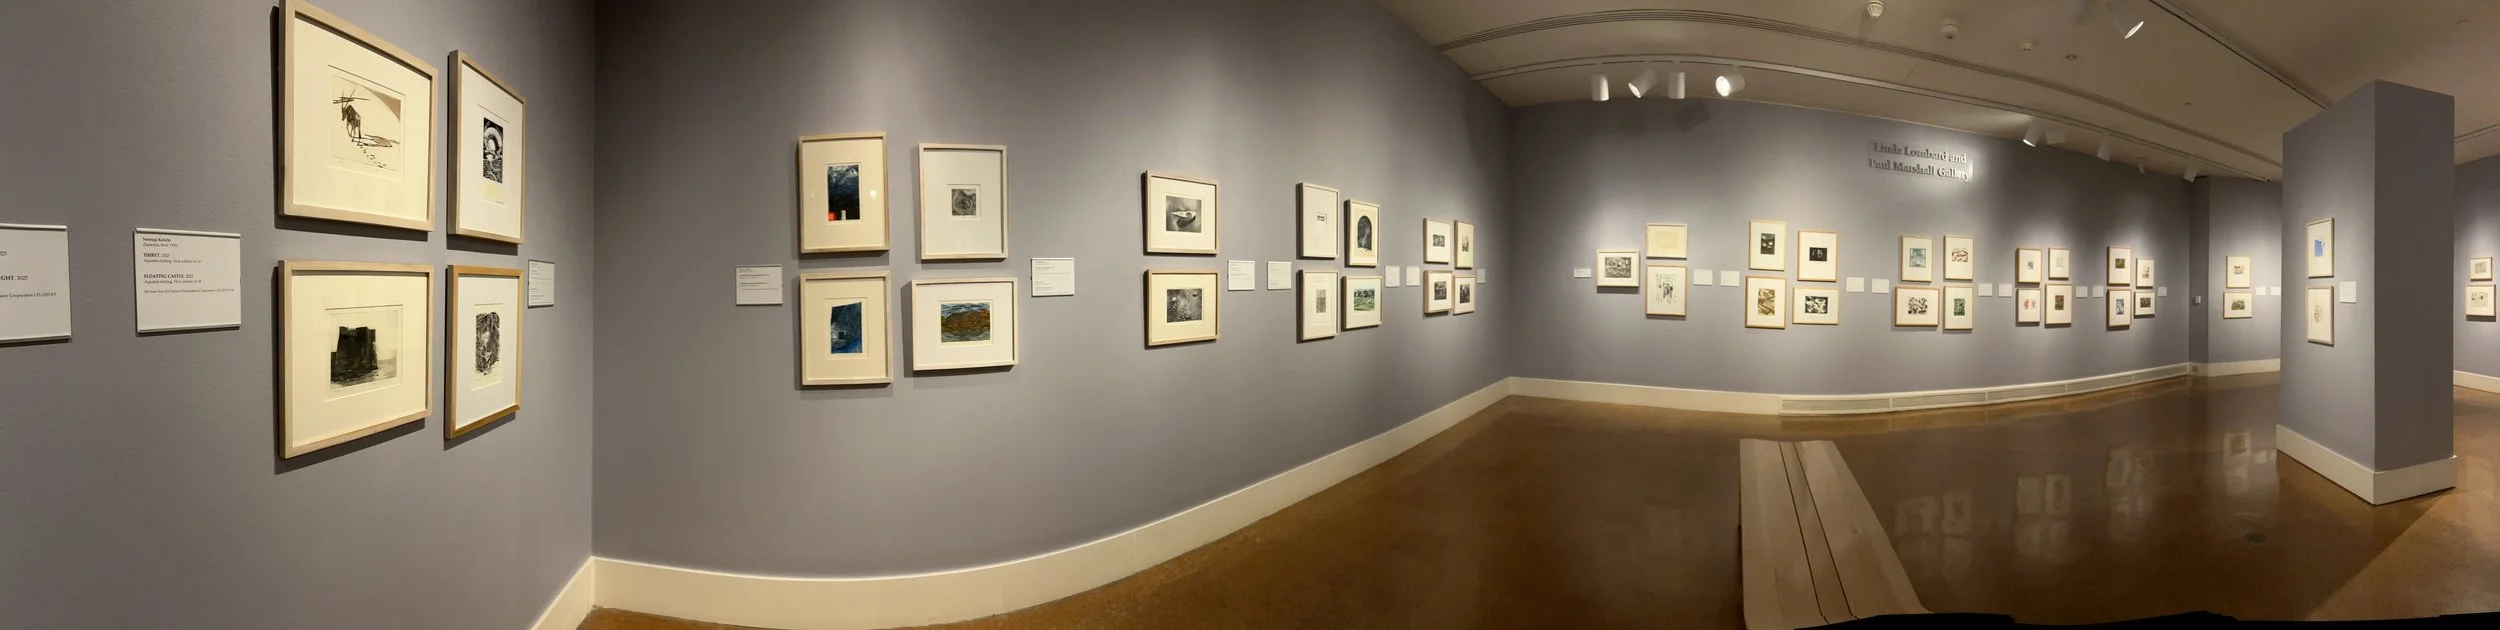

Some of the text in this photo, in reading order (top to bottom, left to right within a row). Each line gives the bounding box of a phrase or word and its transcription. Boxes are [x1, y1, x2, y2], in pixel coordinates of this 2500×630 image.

[1873, 142, 1967, 164] Linda Lombard and
[1869, 158, 1970, 182] Paul Marshall Gallery
